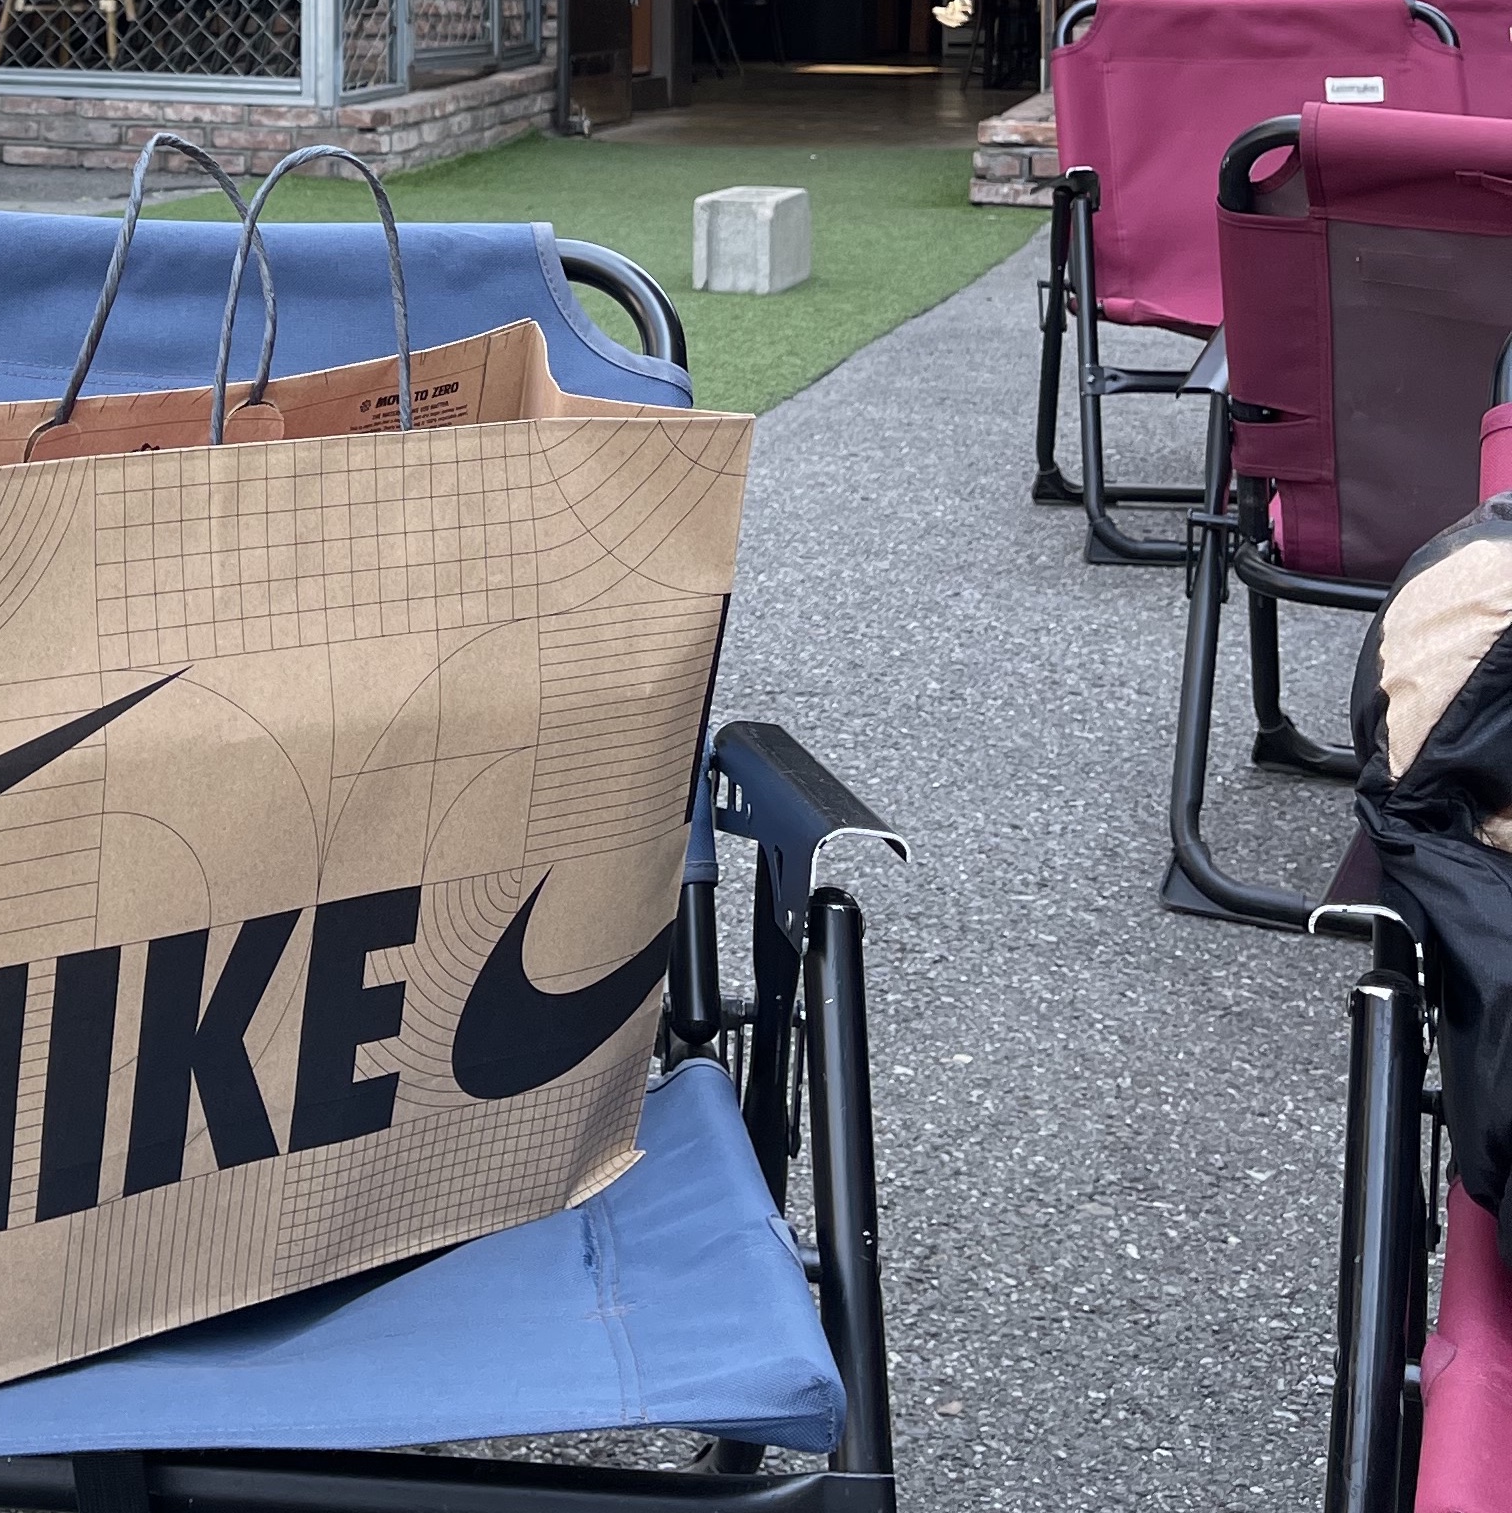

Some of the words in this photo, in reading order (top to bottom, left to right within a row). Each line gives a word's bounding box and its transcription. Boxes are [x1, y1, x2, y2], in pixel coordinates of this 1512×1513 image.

[375, 394, 401, 409] MOV
[414, 389, 429, 402] TO
[431, 381, 459, 399] ZERO
